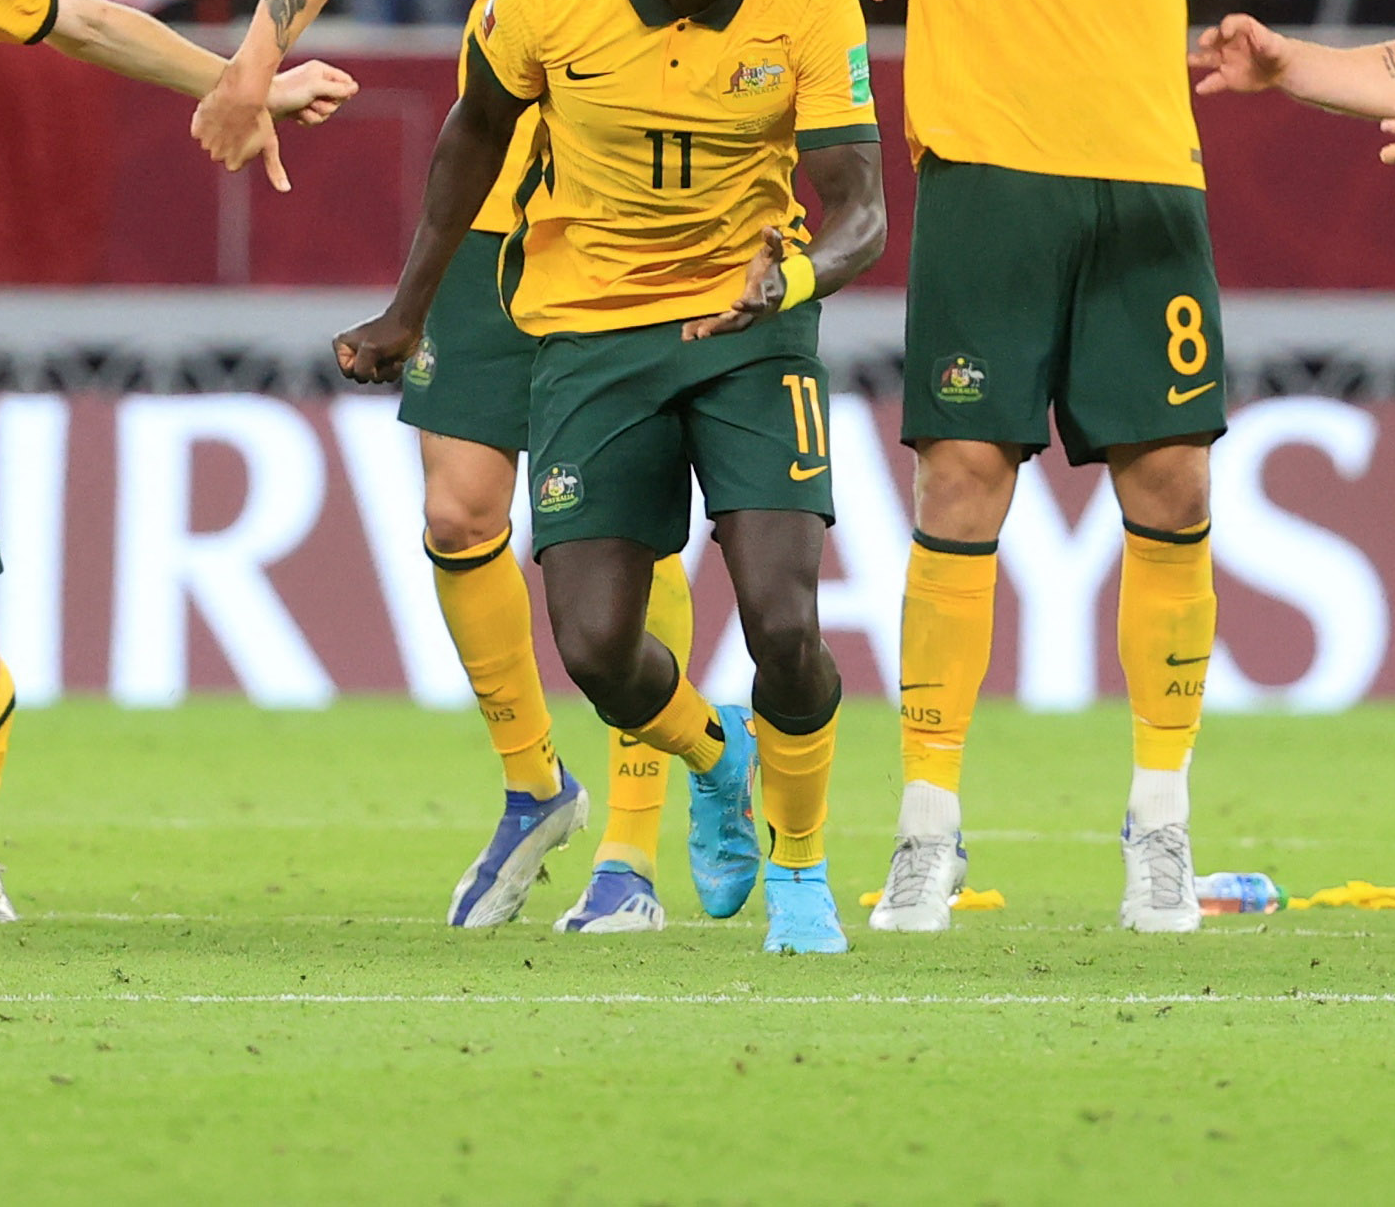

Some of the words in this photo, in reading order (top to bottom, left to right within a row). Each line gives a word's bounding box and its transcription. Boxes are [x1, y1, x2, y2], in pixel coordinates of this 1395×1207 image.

[645, 131, 693, 189] 11
[1165, 295, 1208, 376] 8
[782, 374, 826, 458] 11
[618, 761, 660, 778] AUS
